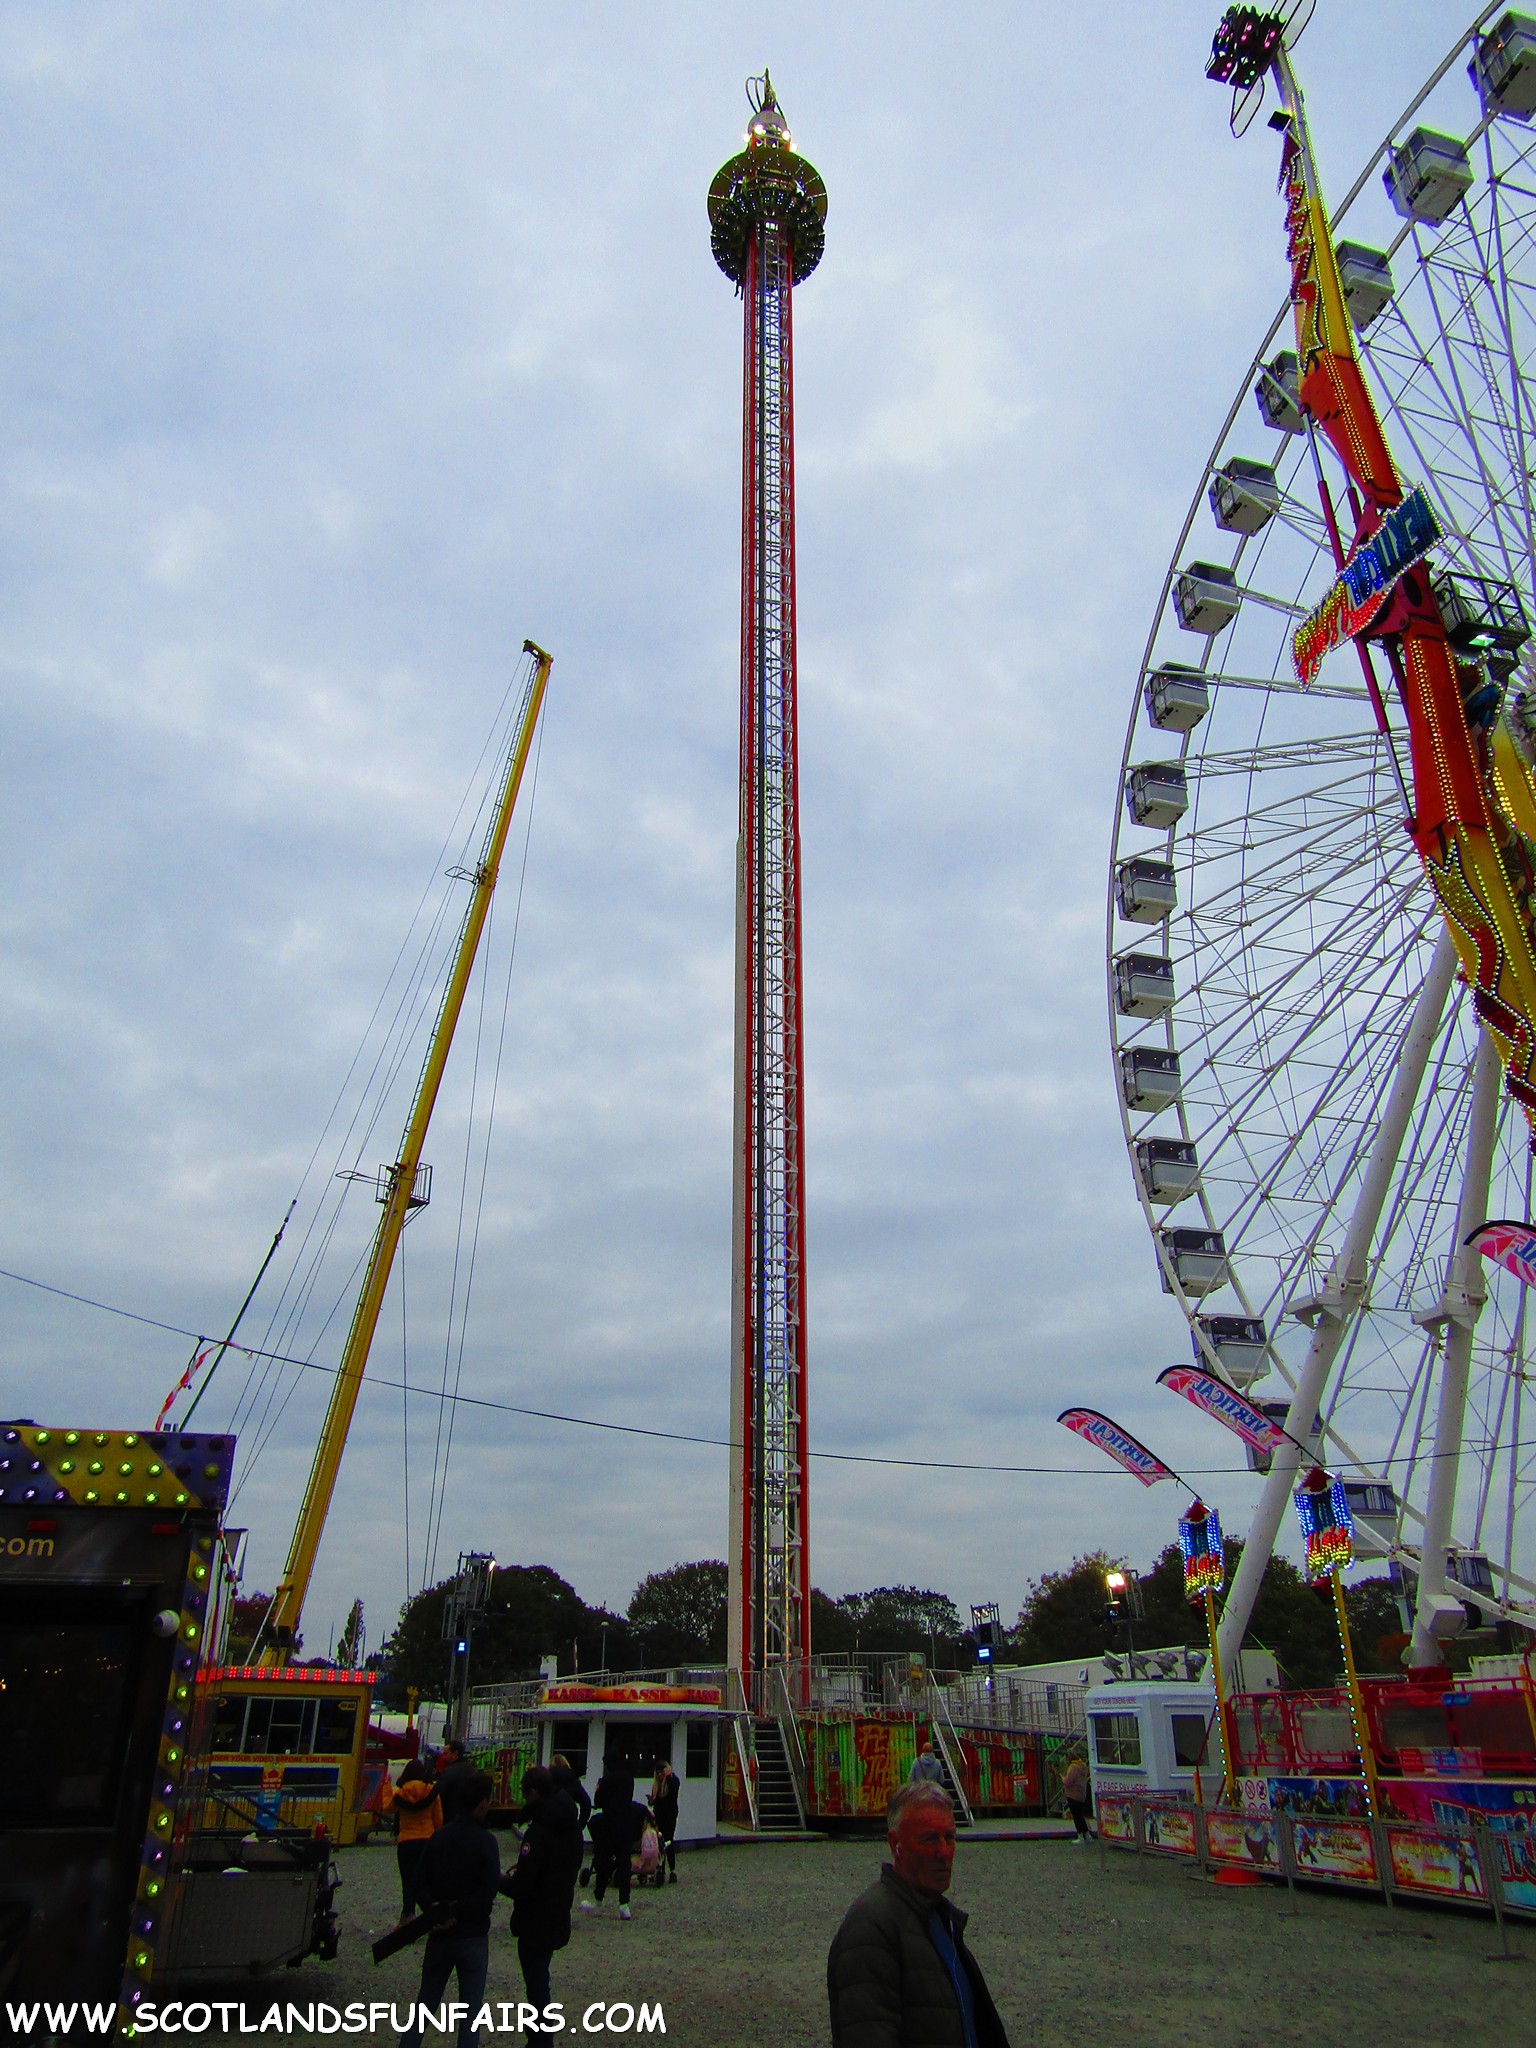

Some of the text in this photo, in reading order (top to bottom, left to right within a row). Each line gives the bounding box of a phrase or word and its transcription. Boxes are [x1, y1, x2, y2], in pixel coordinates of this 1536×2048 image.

[548, 1688, 594, 1700] KASSE
[613, 1688, 671, 1700] KASSE
[687, 1689, 720, 1701] KASSE
[1096, 1781, 1119, 1791] PLEASE
